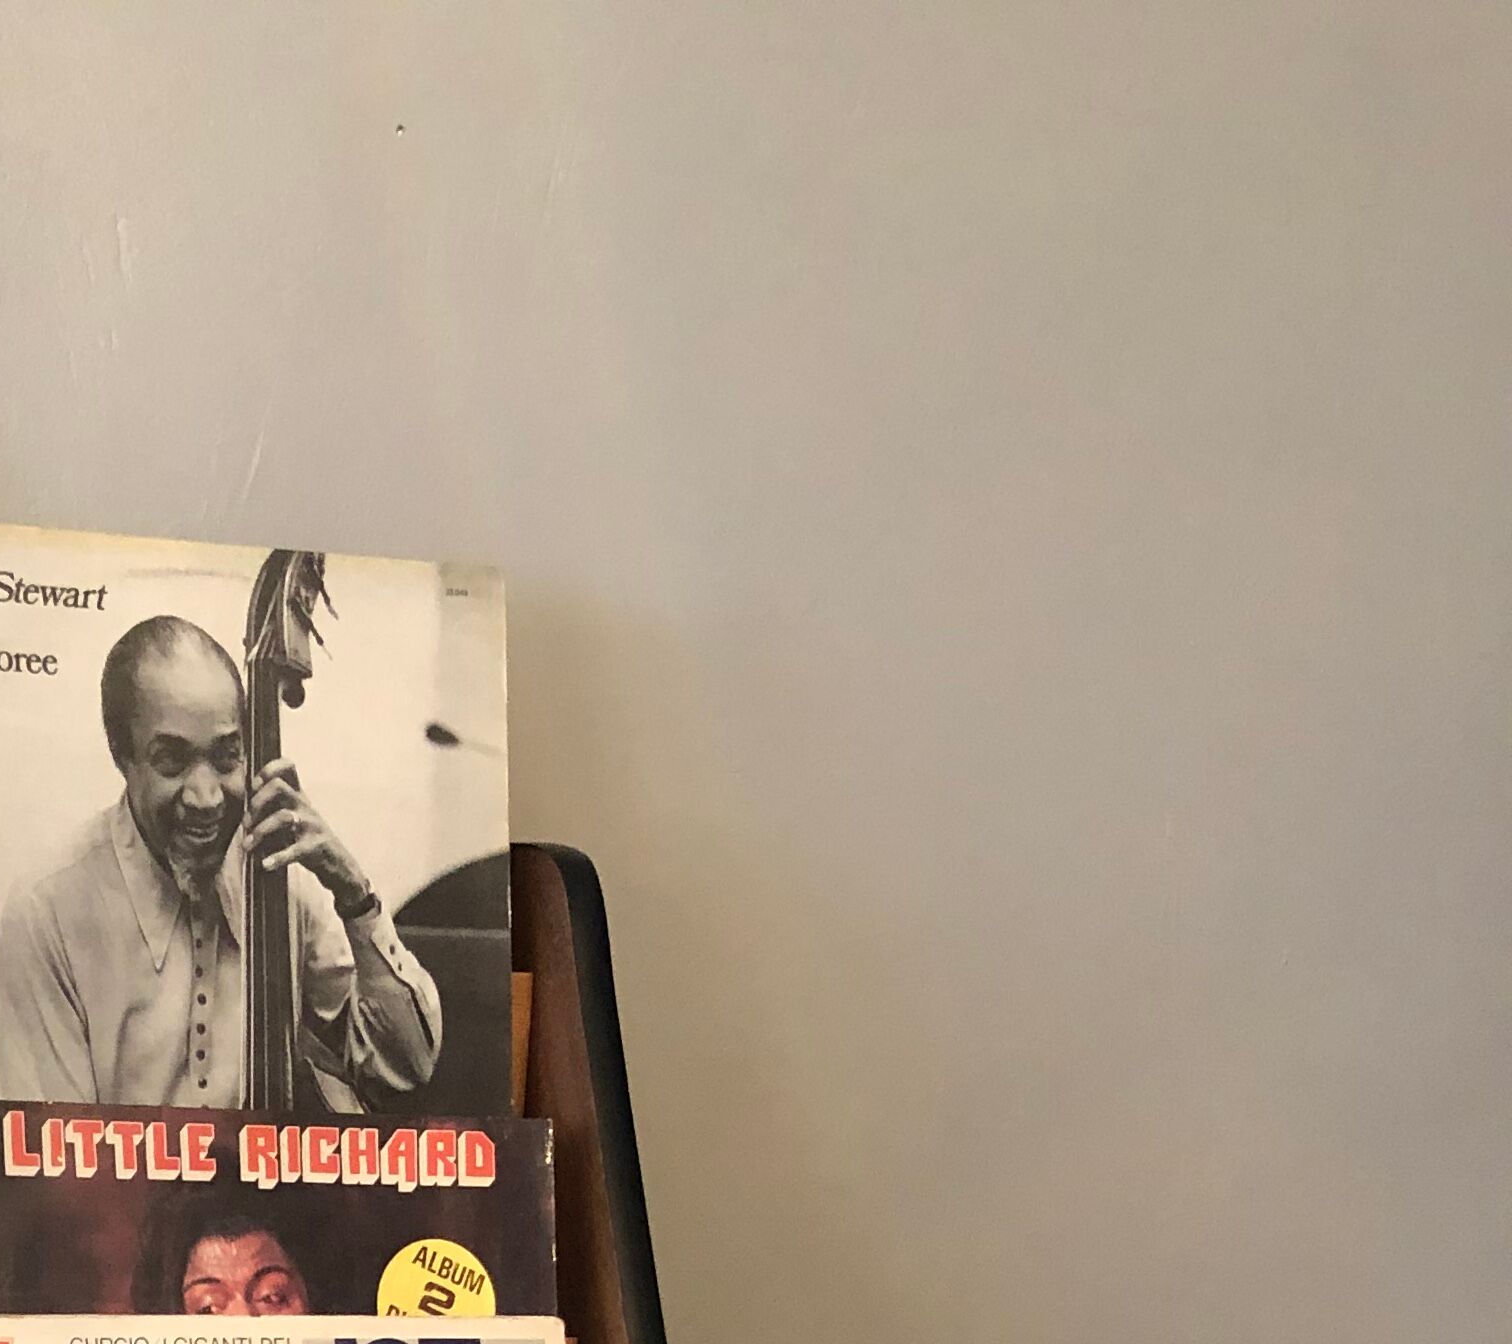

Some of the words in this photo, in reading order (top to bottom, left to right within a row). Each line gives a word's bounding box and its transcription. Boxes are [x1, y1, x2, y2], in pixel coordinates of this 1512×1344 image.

[2, 1110, 217, 1182] LITTLE
[238, 1124, 496, 1192] RICHARD
[411, 1246, 486, 1296] ALBUM
[418, 1281, 456, 1316] 2
